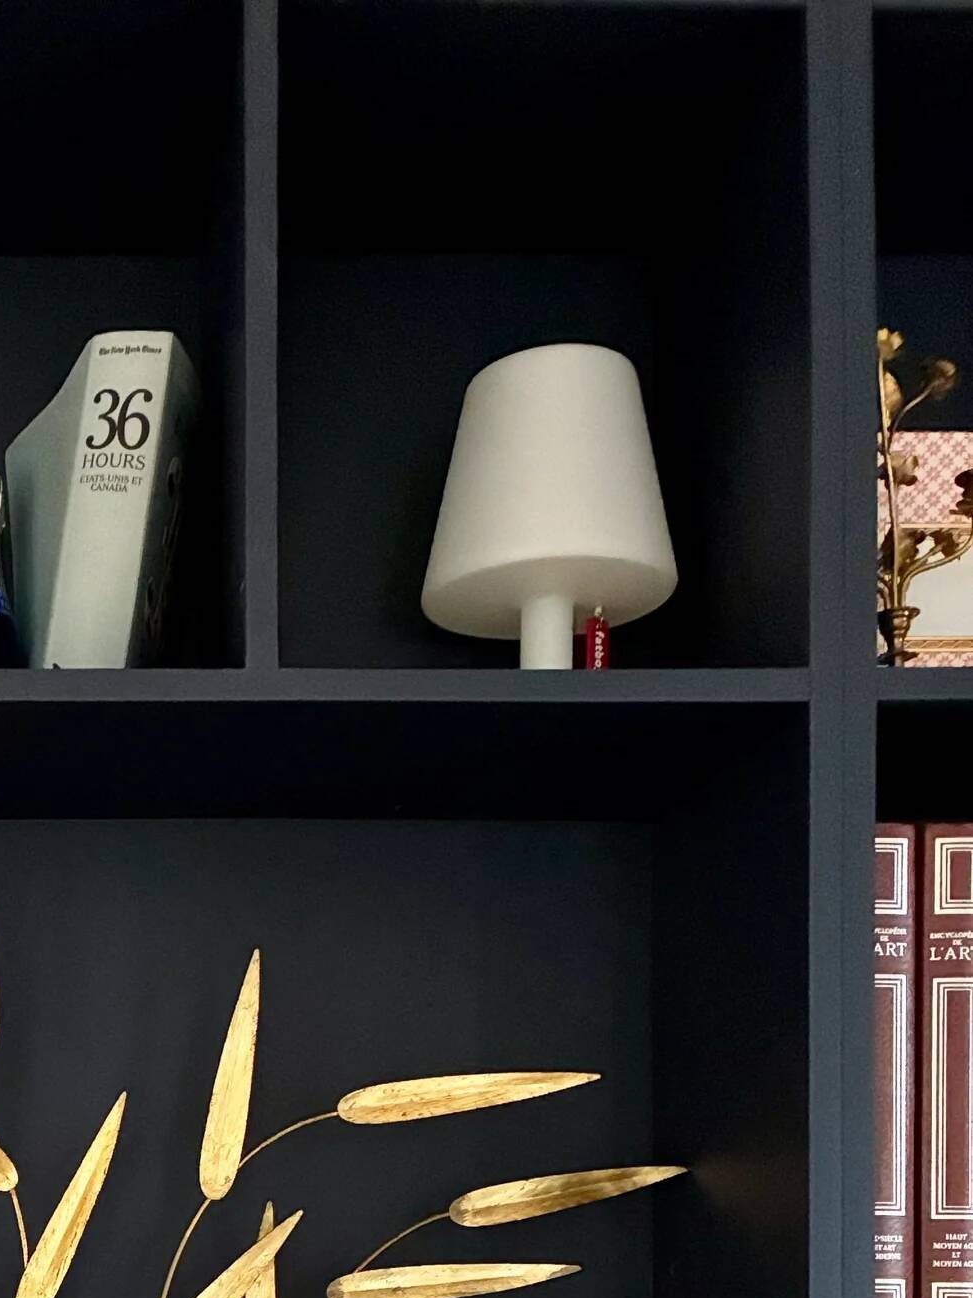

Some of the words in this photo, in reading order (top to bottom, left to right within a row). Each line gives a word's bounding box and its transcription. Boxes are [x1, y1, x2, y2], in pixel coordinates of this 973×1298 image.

[85, 388, 153, 450] 36
[81, 452, 146, 470] HOURS
[90, 483, 128, 492] CANADA
[932, 1242, 963, 1250] MOYEN
[932, 1260, 963, 1268] MOYEN
